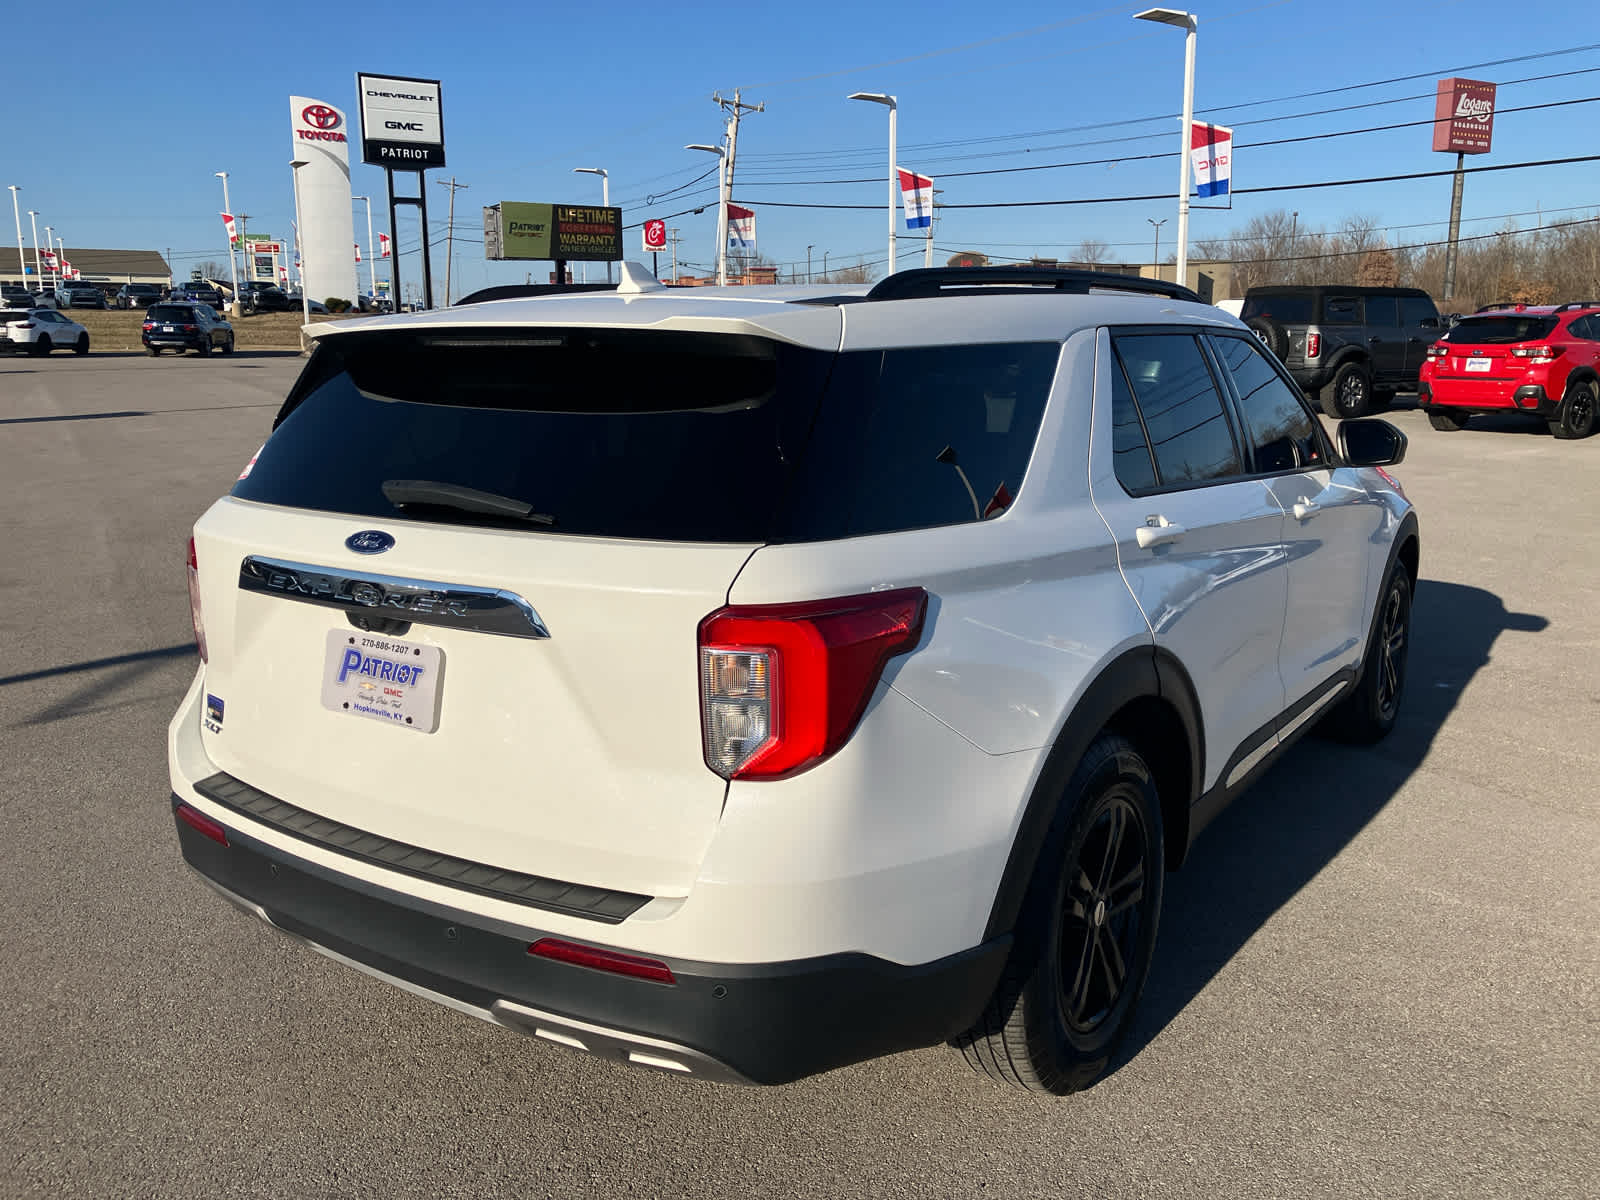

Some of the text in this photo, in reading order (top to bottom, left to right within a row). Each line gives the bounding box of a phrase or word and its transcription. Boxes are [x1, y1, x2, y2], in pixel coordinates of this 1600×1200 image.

[366, 91, 434, 102] CHEVROLET
[385, 121, 424, 131] GMC
[296, 129, 347, 142] TOYOTA
[381, 147, 429, 159] PATRIOT
[558, 207, 615, 223] LIFETIME
[509, 221, 545, 234] PATRIOT
[560, 233, 616, 246] WARRANTY
[266, 572, 468, 617] EXPLORER
[361, 638, 409, 655] 270-886-1207
[338, 647, 424, 687] PATRIOT
[383, 687, 403, 698] GMC
[353, 703, 403, 721] Hopkinsville, KY
